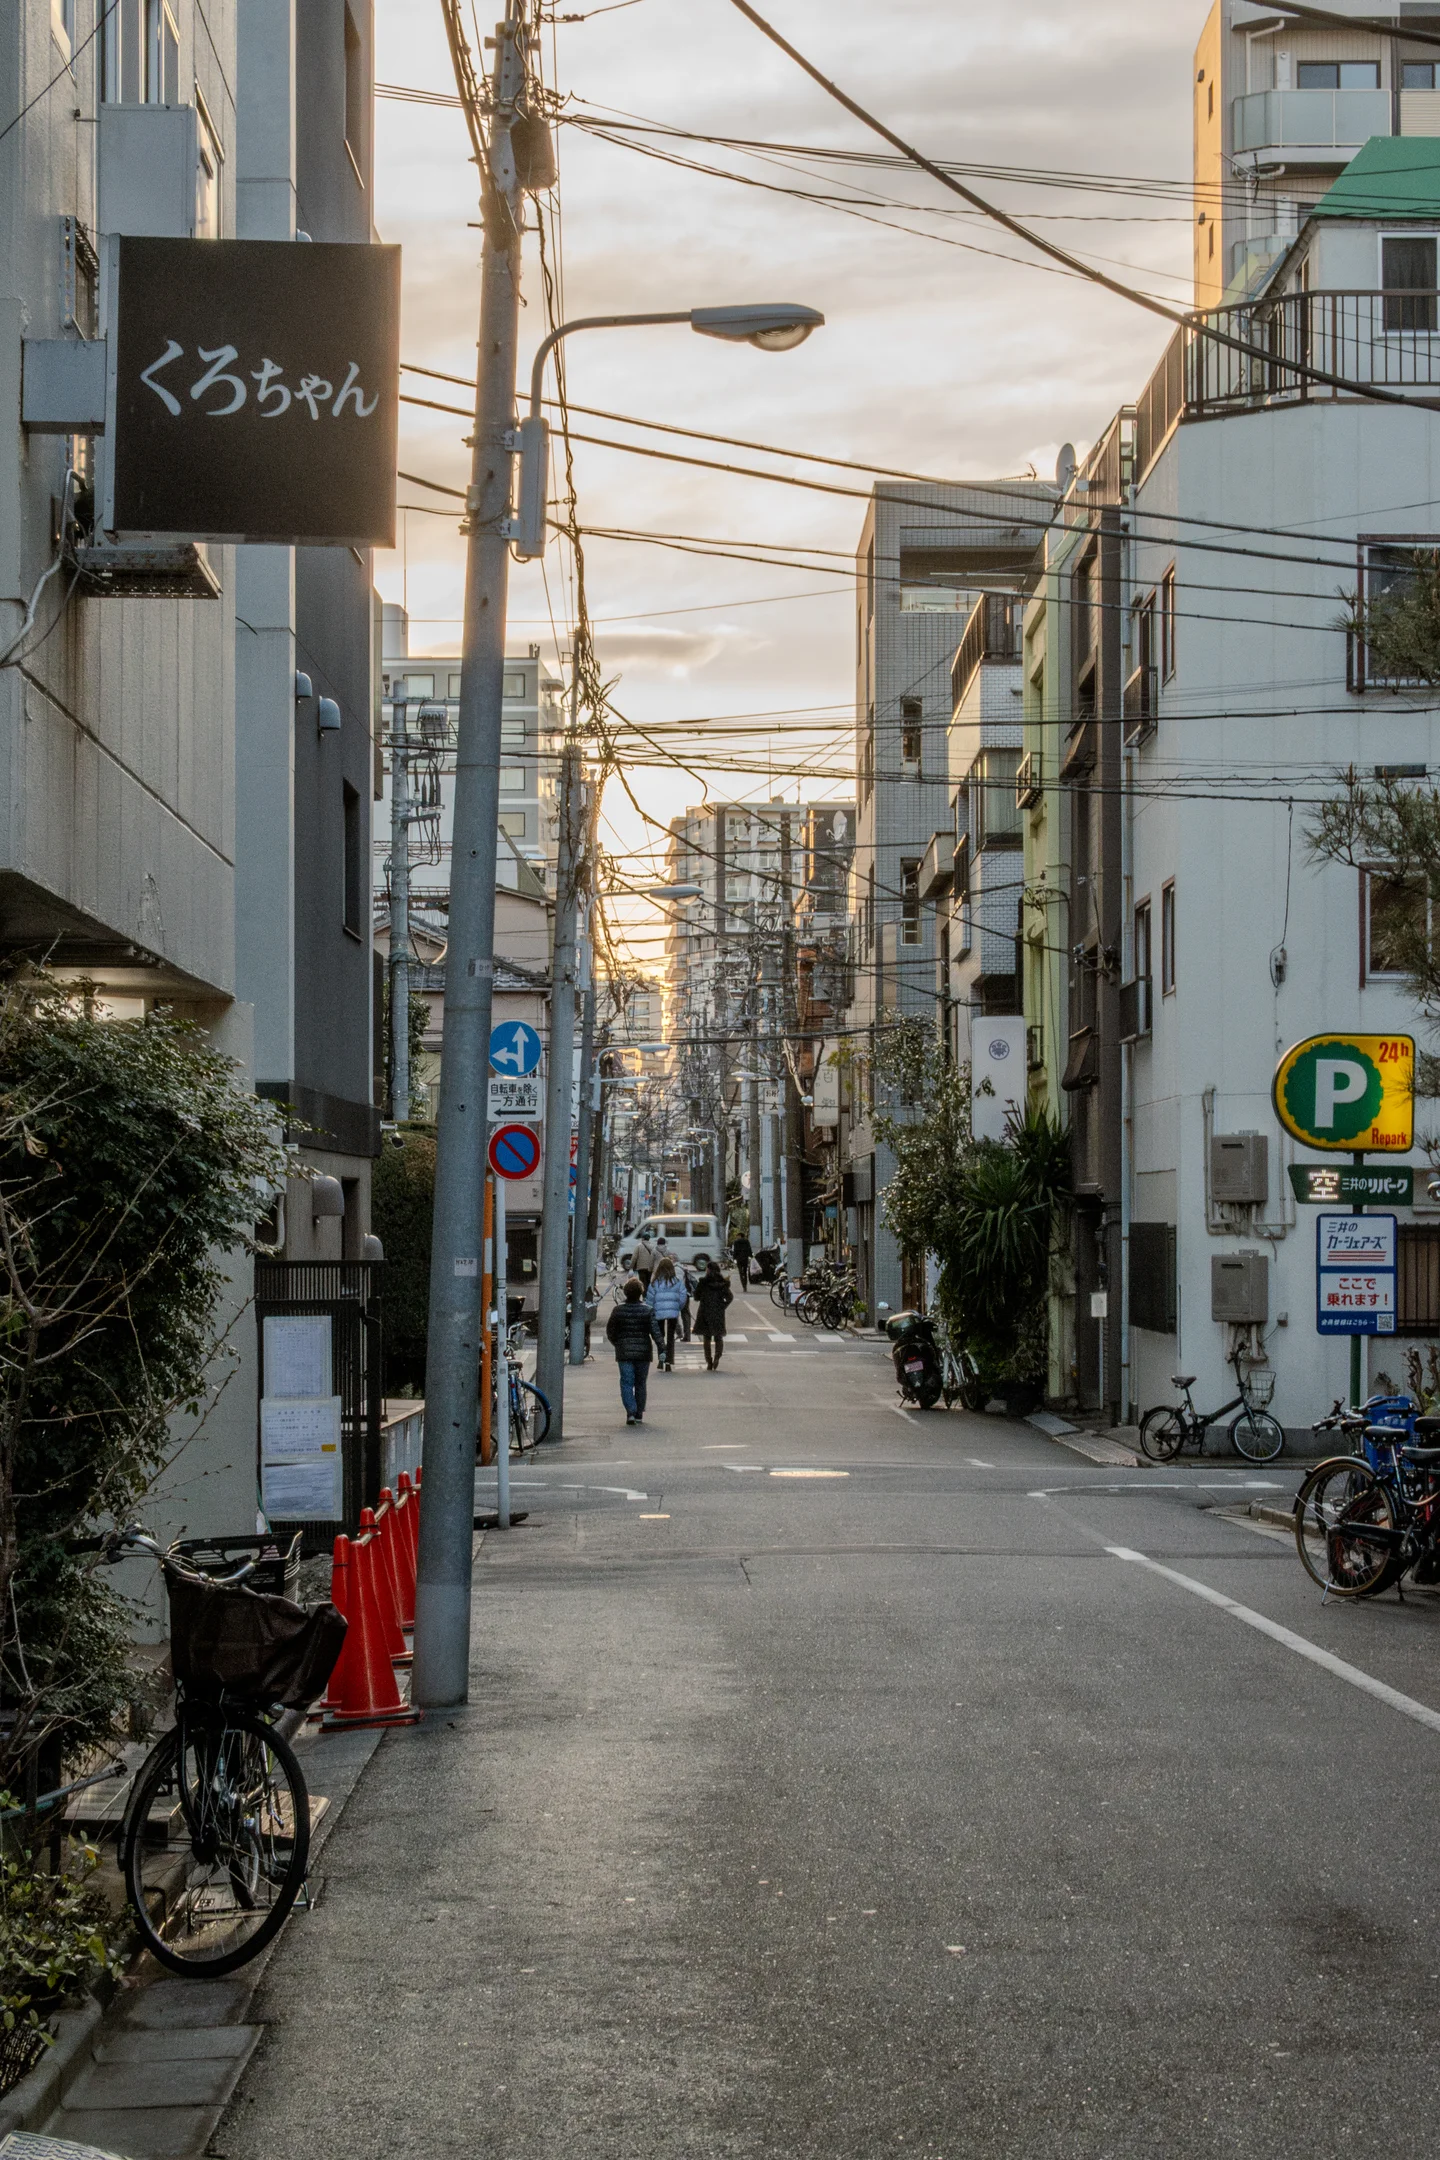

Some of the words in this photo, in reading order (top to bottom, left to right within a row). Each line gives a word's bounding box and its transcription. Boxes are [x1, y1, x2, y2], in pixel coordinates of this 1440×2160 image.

[140, 340, 379, 421] くろちゃん
[1379, 1041, 1409, 1063] 24h
[490, 1083, 538, 1095] 自転車を除く
[1314, 1058, 1368, 1128] P
[490, 1095, 538, 1107] 一方通行
[1371, 1127, 1407, 1146] Repark
[1308, 1168, 1339, 1200] 空
[1341, 1177, 1409, 1195] 三井のリパーク
[1326, 1221, 1358, 1233] 三井の
[1338, 1277, 1377, 1290] ここで
[1326, 1293, 1389, 1307] 乗れます！
